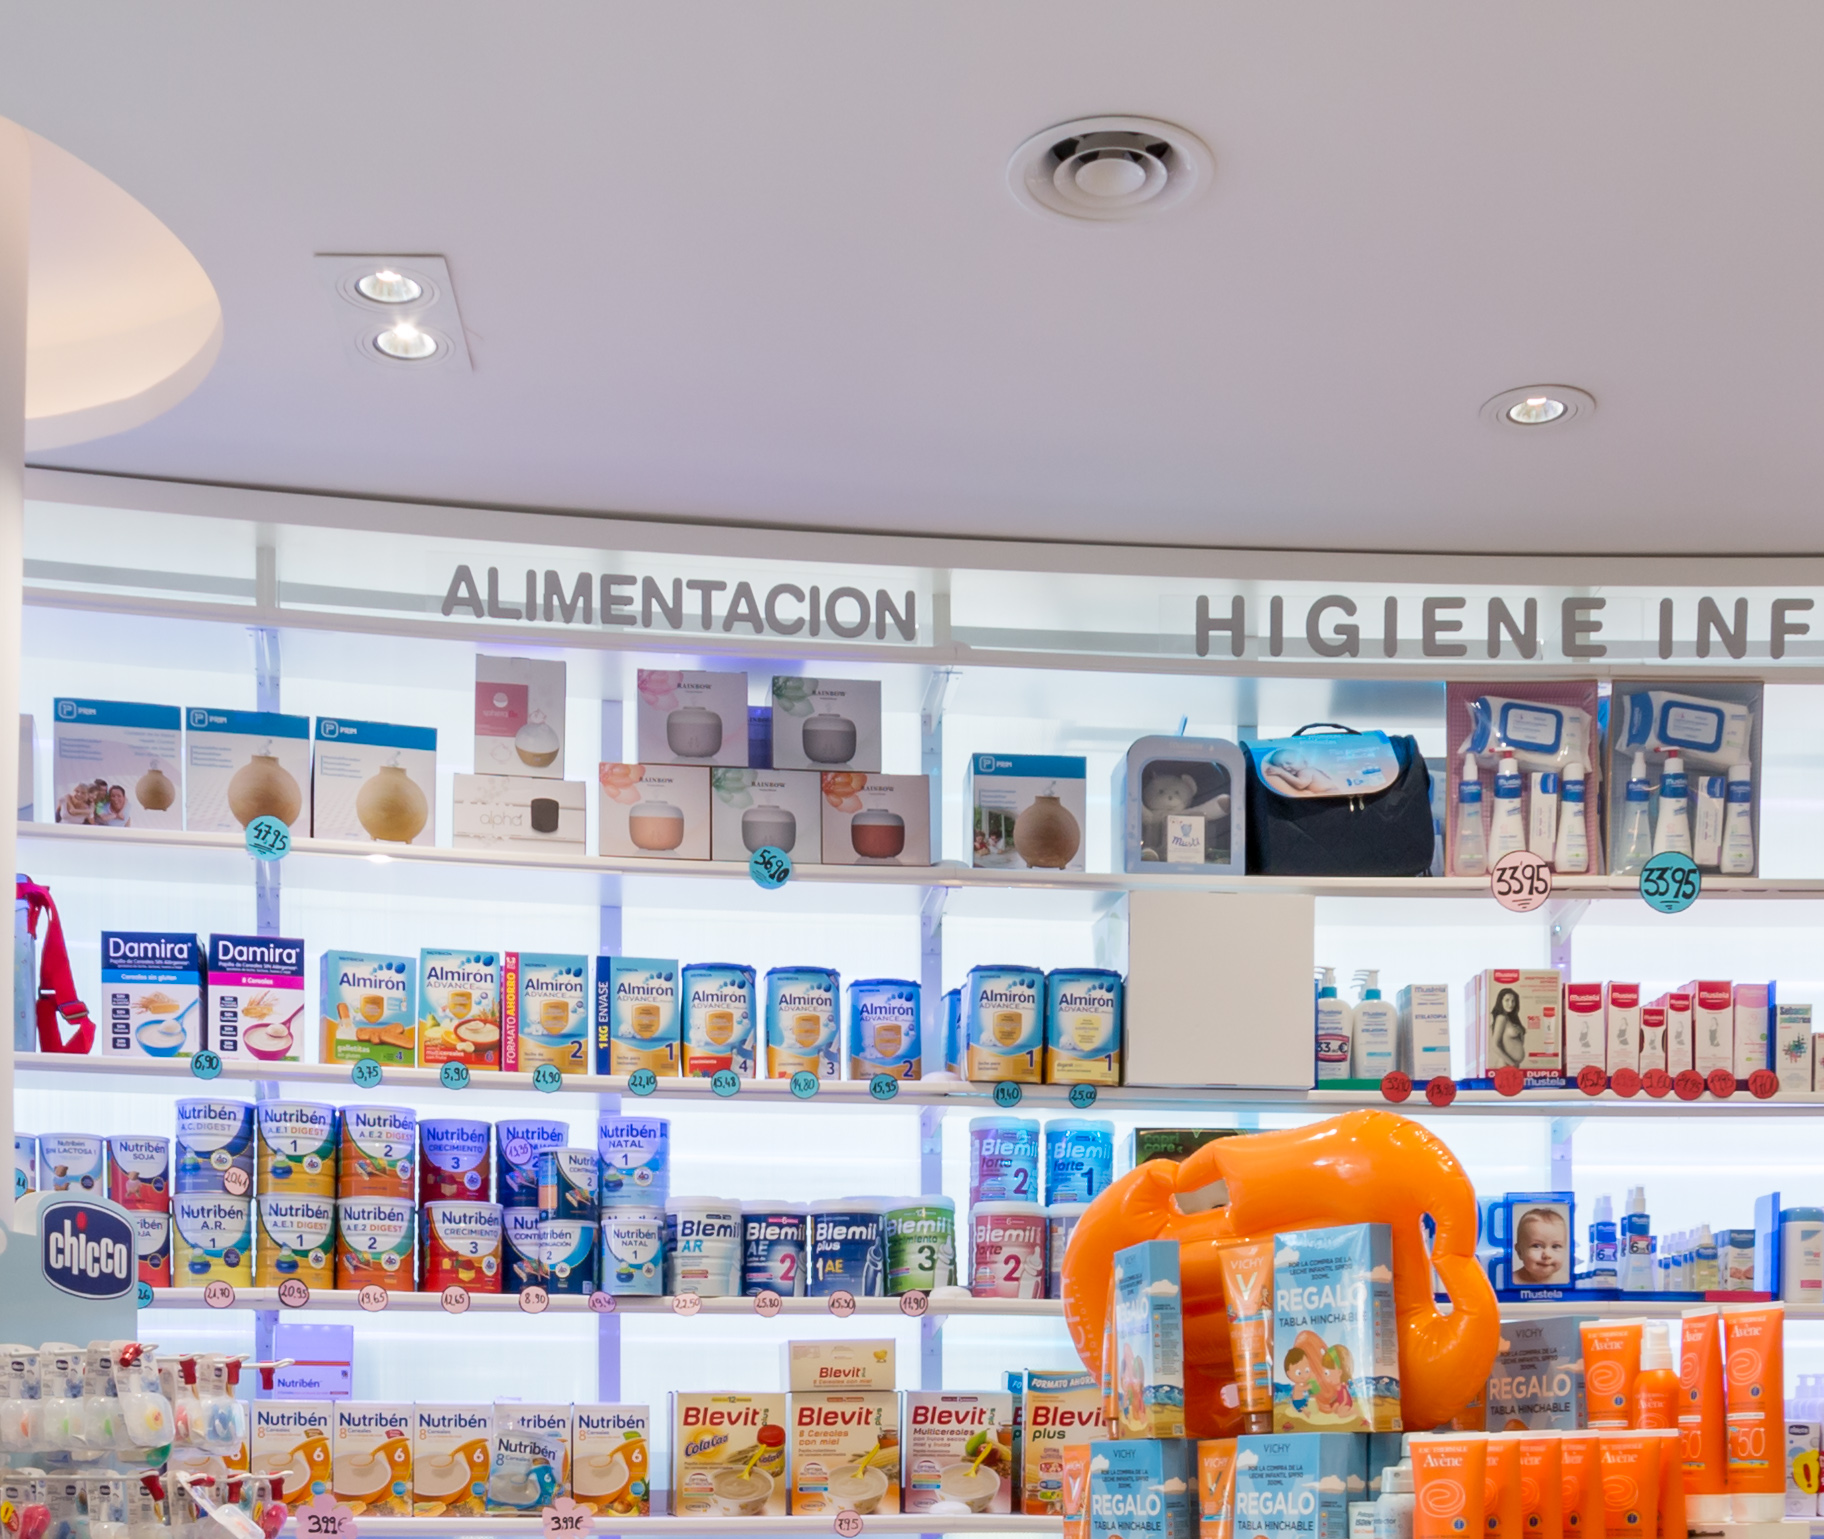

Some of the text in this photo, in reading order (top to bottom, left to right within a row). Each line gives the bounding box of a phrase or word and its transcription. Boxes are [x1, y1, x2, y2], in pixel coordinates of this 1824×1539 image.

[441, 564, 916, 641] ALIMENTACION
[1195, 594, 1607, 659] HIGIENE
[109, 937, 192, 961] Damira
[218, 940, 300, 965] Damira
[339, 970, 407, 991] Almirón
[426, 967, 494, 984] Almirón
[616, 980, 675, 997] Almirón
[979, 989, 1035, 1005] Almirón
[597, 980, 610, 1027] ENVASE
[691, 990, 747, 1007] Almirón
[1058, 992, 1115, 1008] Almirón
[860, 1002, 914, 1018] Almirón
[264, 1109, 327, 1126] Nutribén
[426, 1128, 486, 1144] Nutribén
[600, 1123, 658, 1140] Nutribén
[609, 1139, 644, 1150] NATAL
[180, 1203, 244, 1221] Nutribén
[680, 1217, 740, 1239] Blemil
[746, 1222, 805, 1241] Blemil
[815, 1216, 877, 1241] Blemil
[681, 1239, 703, 1254] AR
[1230, 1258, 1264, 1268] VICHY
[1490, 1374, 1571, 1399] REGALO
[257, 1410, 329, 1427] Nutribén
[339, 1411, 409, 1428] Nutribén
[579, 1413, 646, 1429] Nutribén
[683, 1407, 760, 1426] Blevit
[797, 1407, 873, 1426] Blevit
[1263, 1443, 1290, 1454] VICHY
[1423, 1454, 1463, 1467] Avène
[1092, 1494, 1161, 1516] REGALO
[1237, 1492, 1315, 1515] REGALO
[1094, 1520, 1162, 1531] TABLA HINCHABLE
